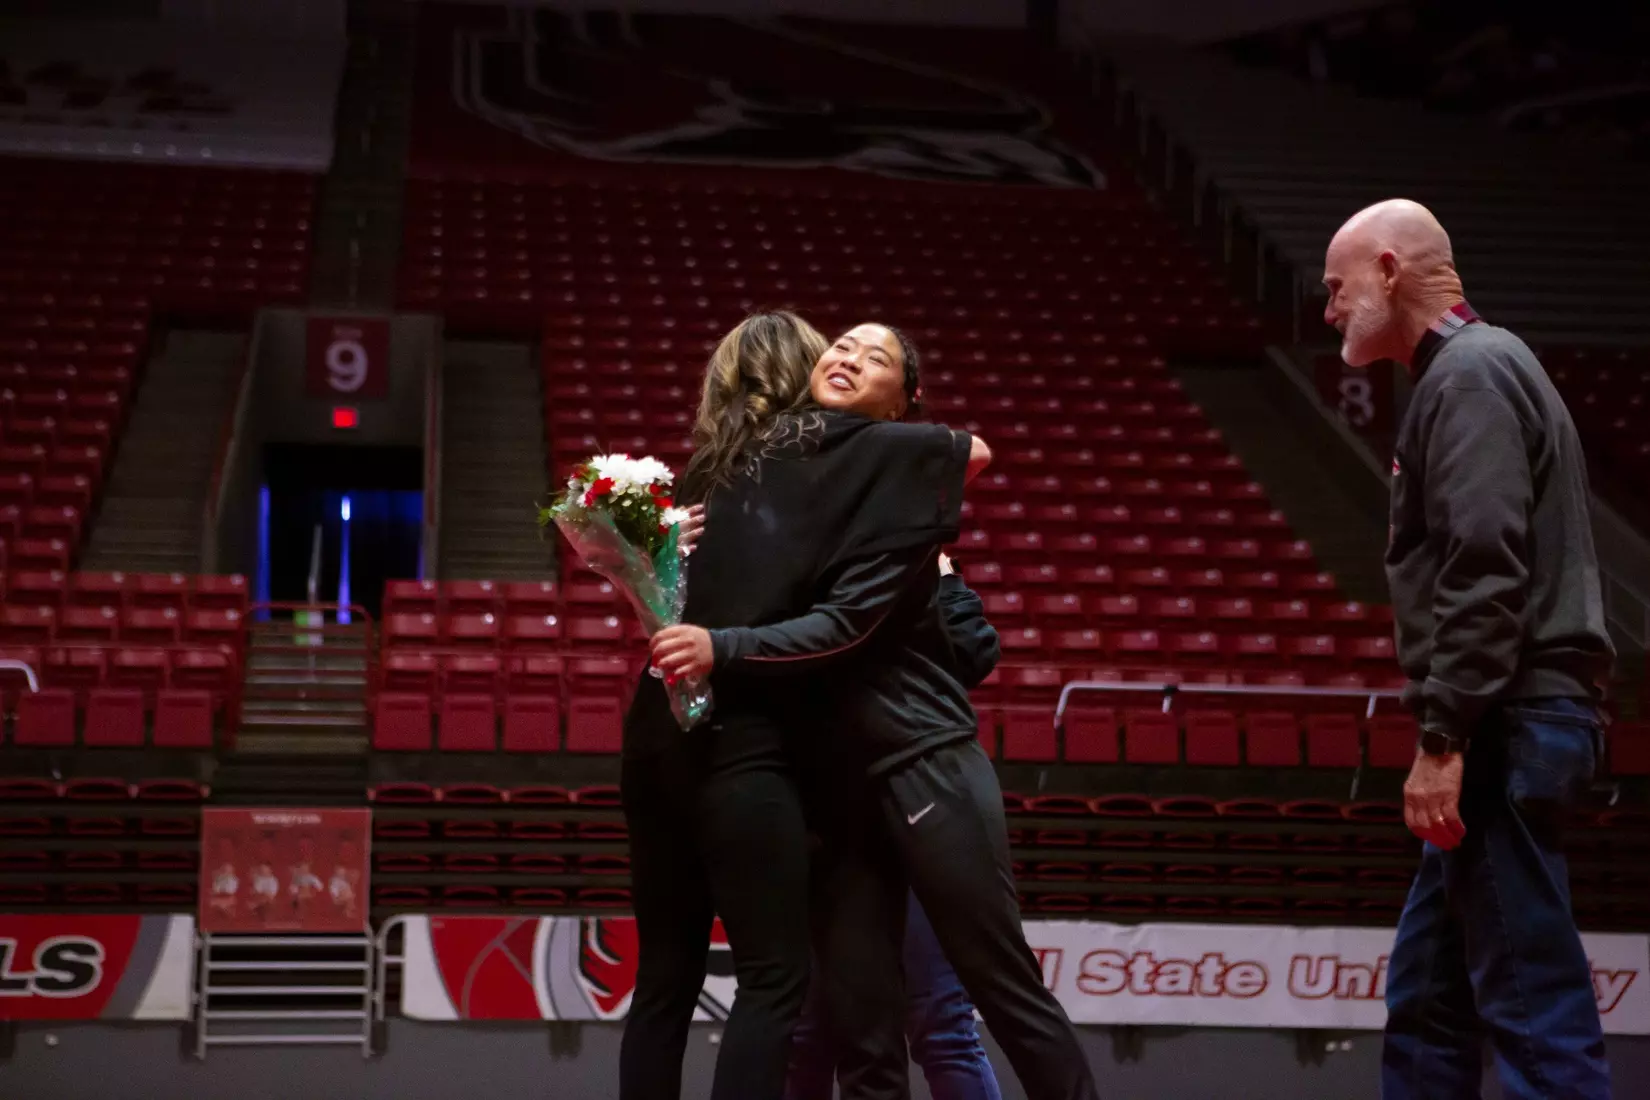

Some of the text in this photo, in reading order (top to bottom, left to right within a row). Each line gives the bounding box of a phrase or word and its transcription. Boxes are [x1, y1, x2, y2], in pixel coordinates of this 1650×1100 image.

[325, 340, 368, 392] 9
[1338, 376, 1374, 426] 8
[1076, 949, 1268, 998] State
